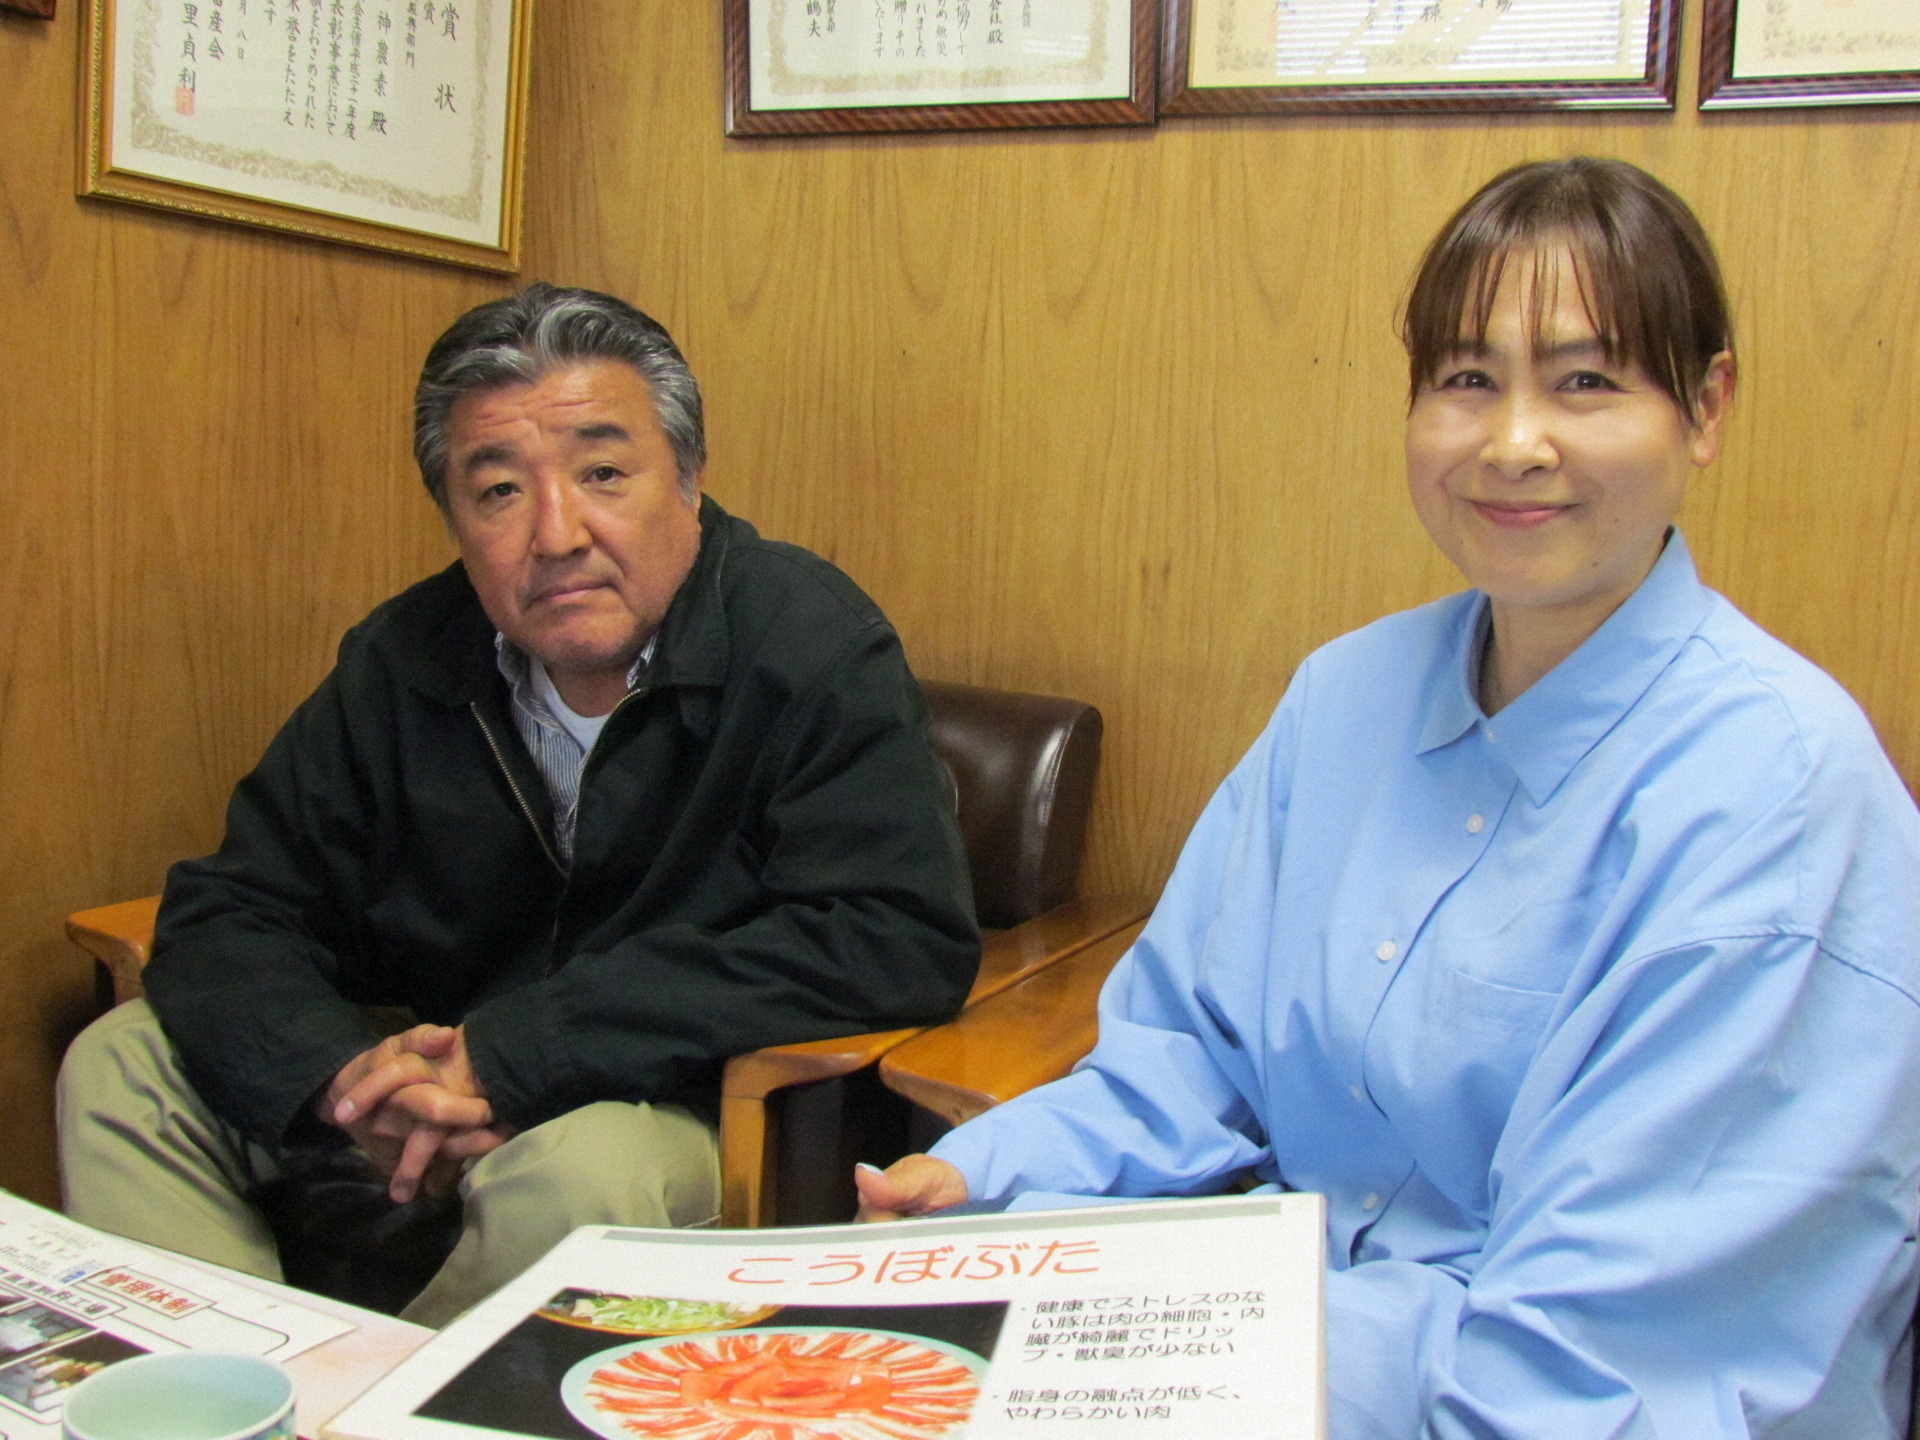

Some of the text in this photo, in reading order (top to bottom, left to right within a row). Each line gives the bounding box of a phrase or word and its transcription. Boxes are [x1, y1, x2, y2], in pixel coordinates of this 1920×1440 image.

[727, 1240, 1101, 1286] こうぼぶた
[98, 1273, 200, 1315] 管理体制
[1031, 1307, 1265, 1330] い豚は肉の細胞・内
[1024, 1327, 1233, 1347] 臓が綺麗でドリッ
[1004, 1405, 1171, 1420] やわらかい肉
